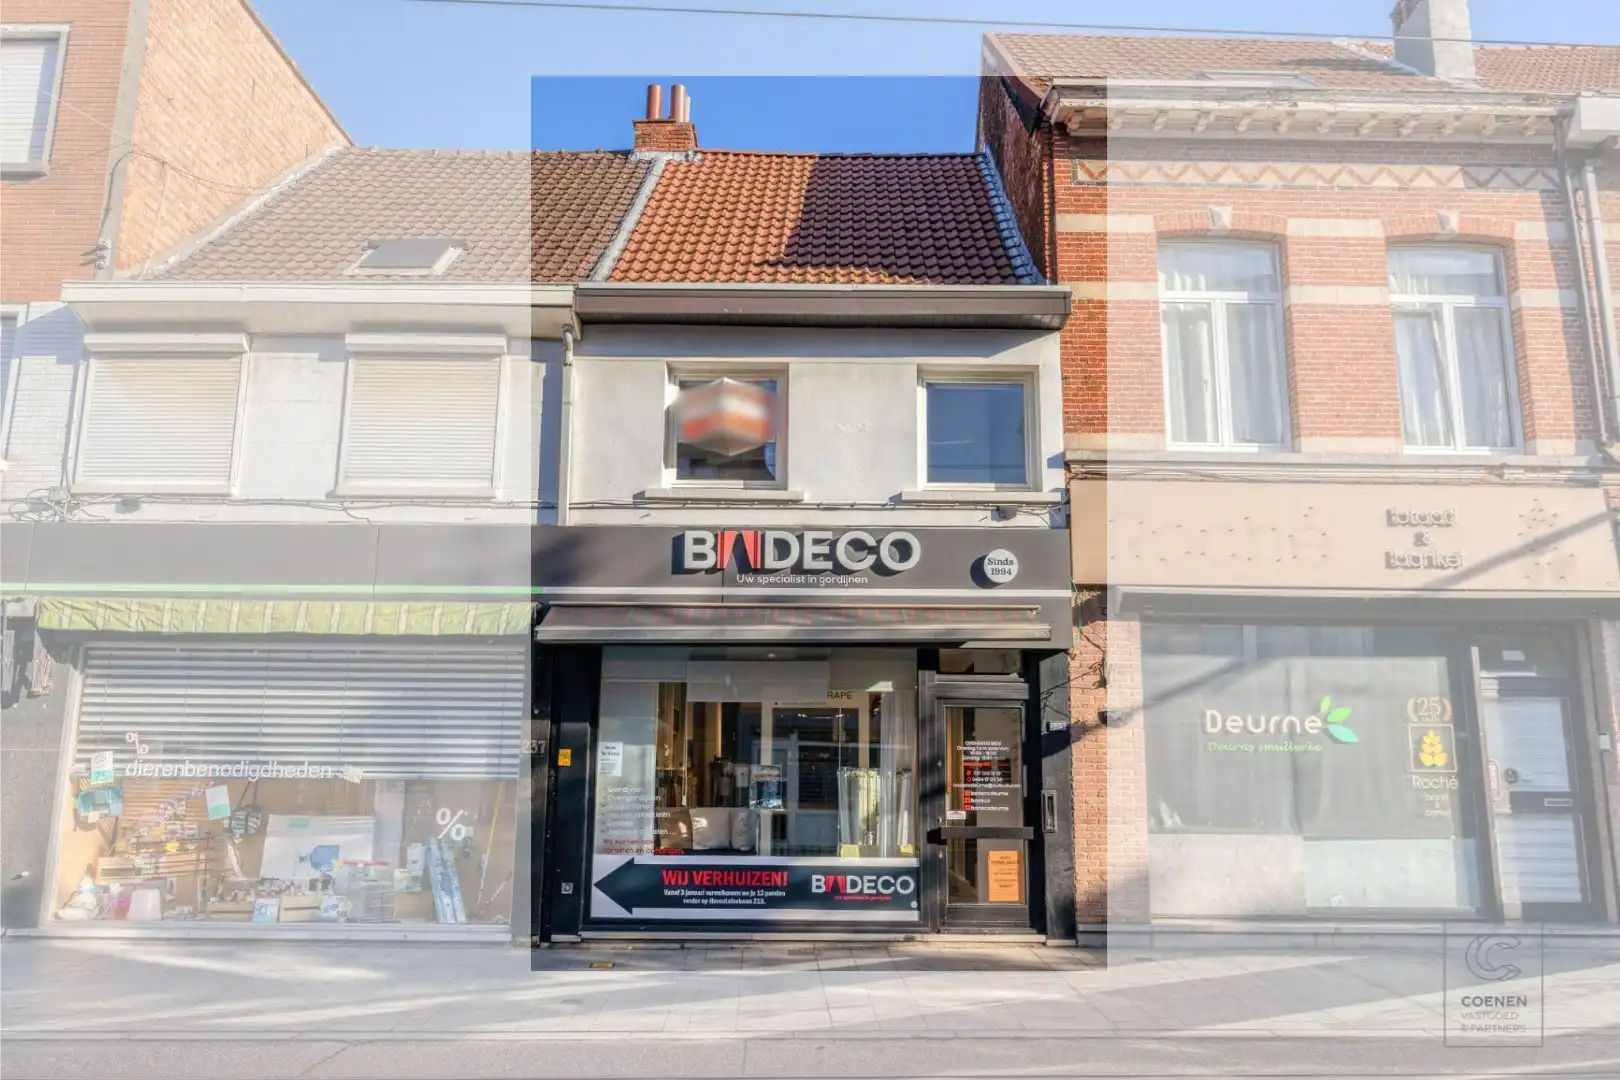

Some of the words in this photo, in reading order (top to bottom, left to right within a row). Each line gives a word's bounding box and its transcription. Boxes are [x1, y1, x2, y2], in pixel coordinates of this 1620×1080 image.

[987, 557, 1015, 566] Sinds
[736, 574, 754, 584] Uw
[756, 573, 806, 585] specialist
[807, 574, 817, 584] in
[818, 574, 868, 587] gordijnen
[990, 567, 1013, 576] 1994
[1416, 697, 1442, 717] 25
[1205, 709, 1323, 734] Deurne
[126, 760, 332, 781] dierenbenodigdheden
[661, 869, 690, 886] WIJ
[691, 869, 789, 887] VERHUIZEN!
